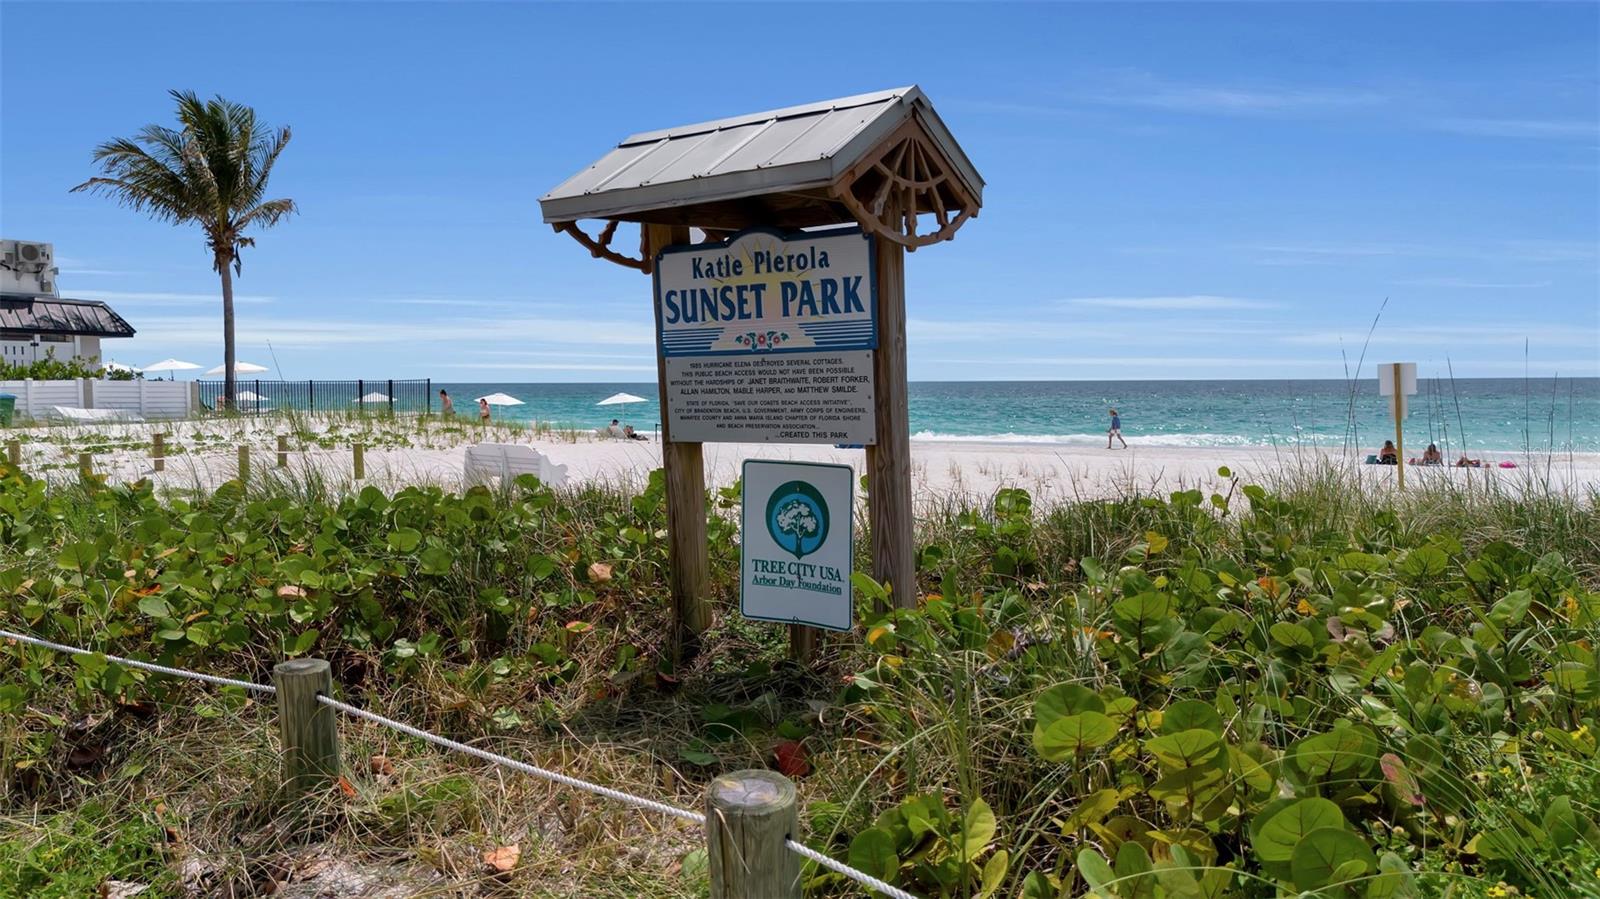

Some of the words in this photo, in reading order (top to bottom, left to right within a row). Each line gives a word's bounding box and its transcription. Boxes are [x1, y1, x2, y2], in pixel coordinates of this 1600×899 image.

[692, 254, 743, 279] Katie
[754, 246, 830, 273] Pierola
[665, 283, 766, 324] SUNSET
[780, 275, 865, 318] PARK
[769, 376, 810, 384] BRAITHWAITE,
[841, 376, 870, 384] FORKER,
[752, 559, 786, 575] TREE
[788, 562, 817, 578] CITY
[752, 575, 778, 586] Arbor
[780, 577, 796, 590] Day
[798, 579, 842, 594] Foundation
